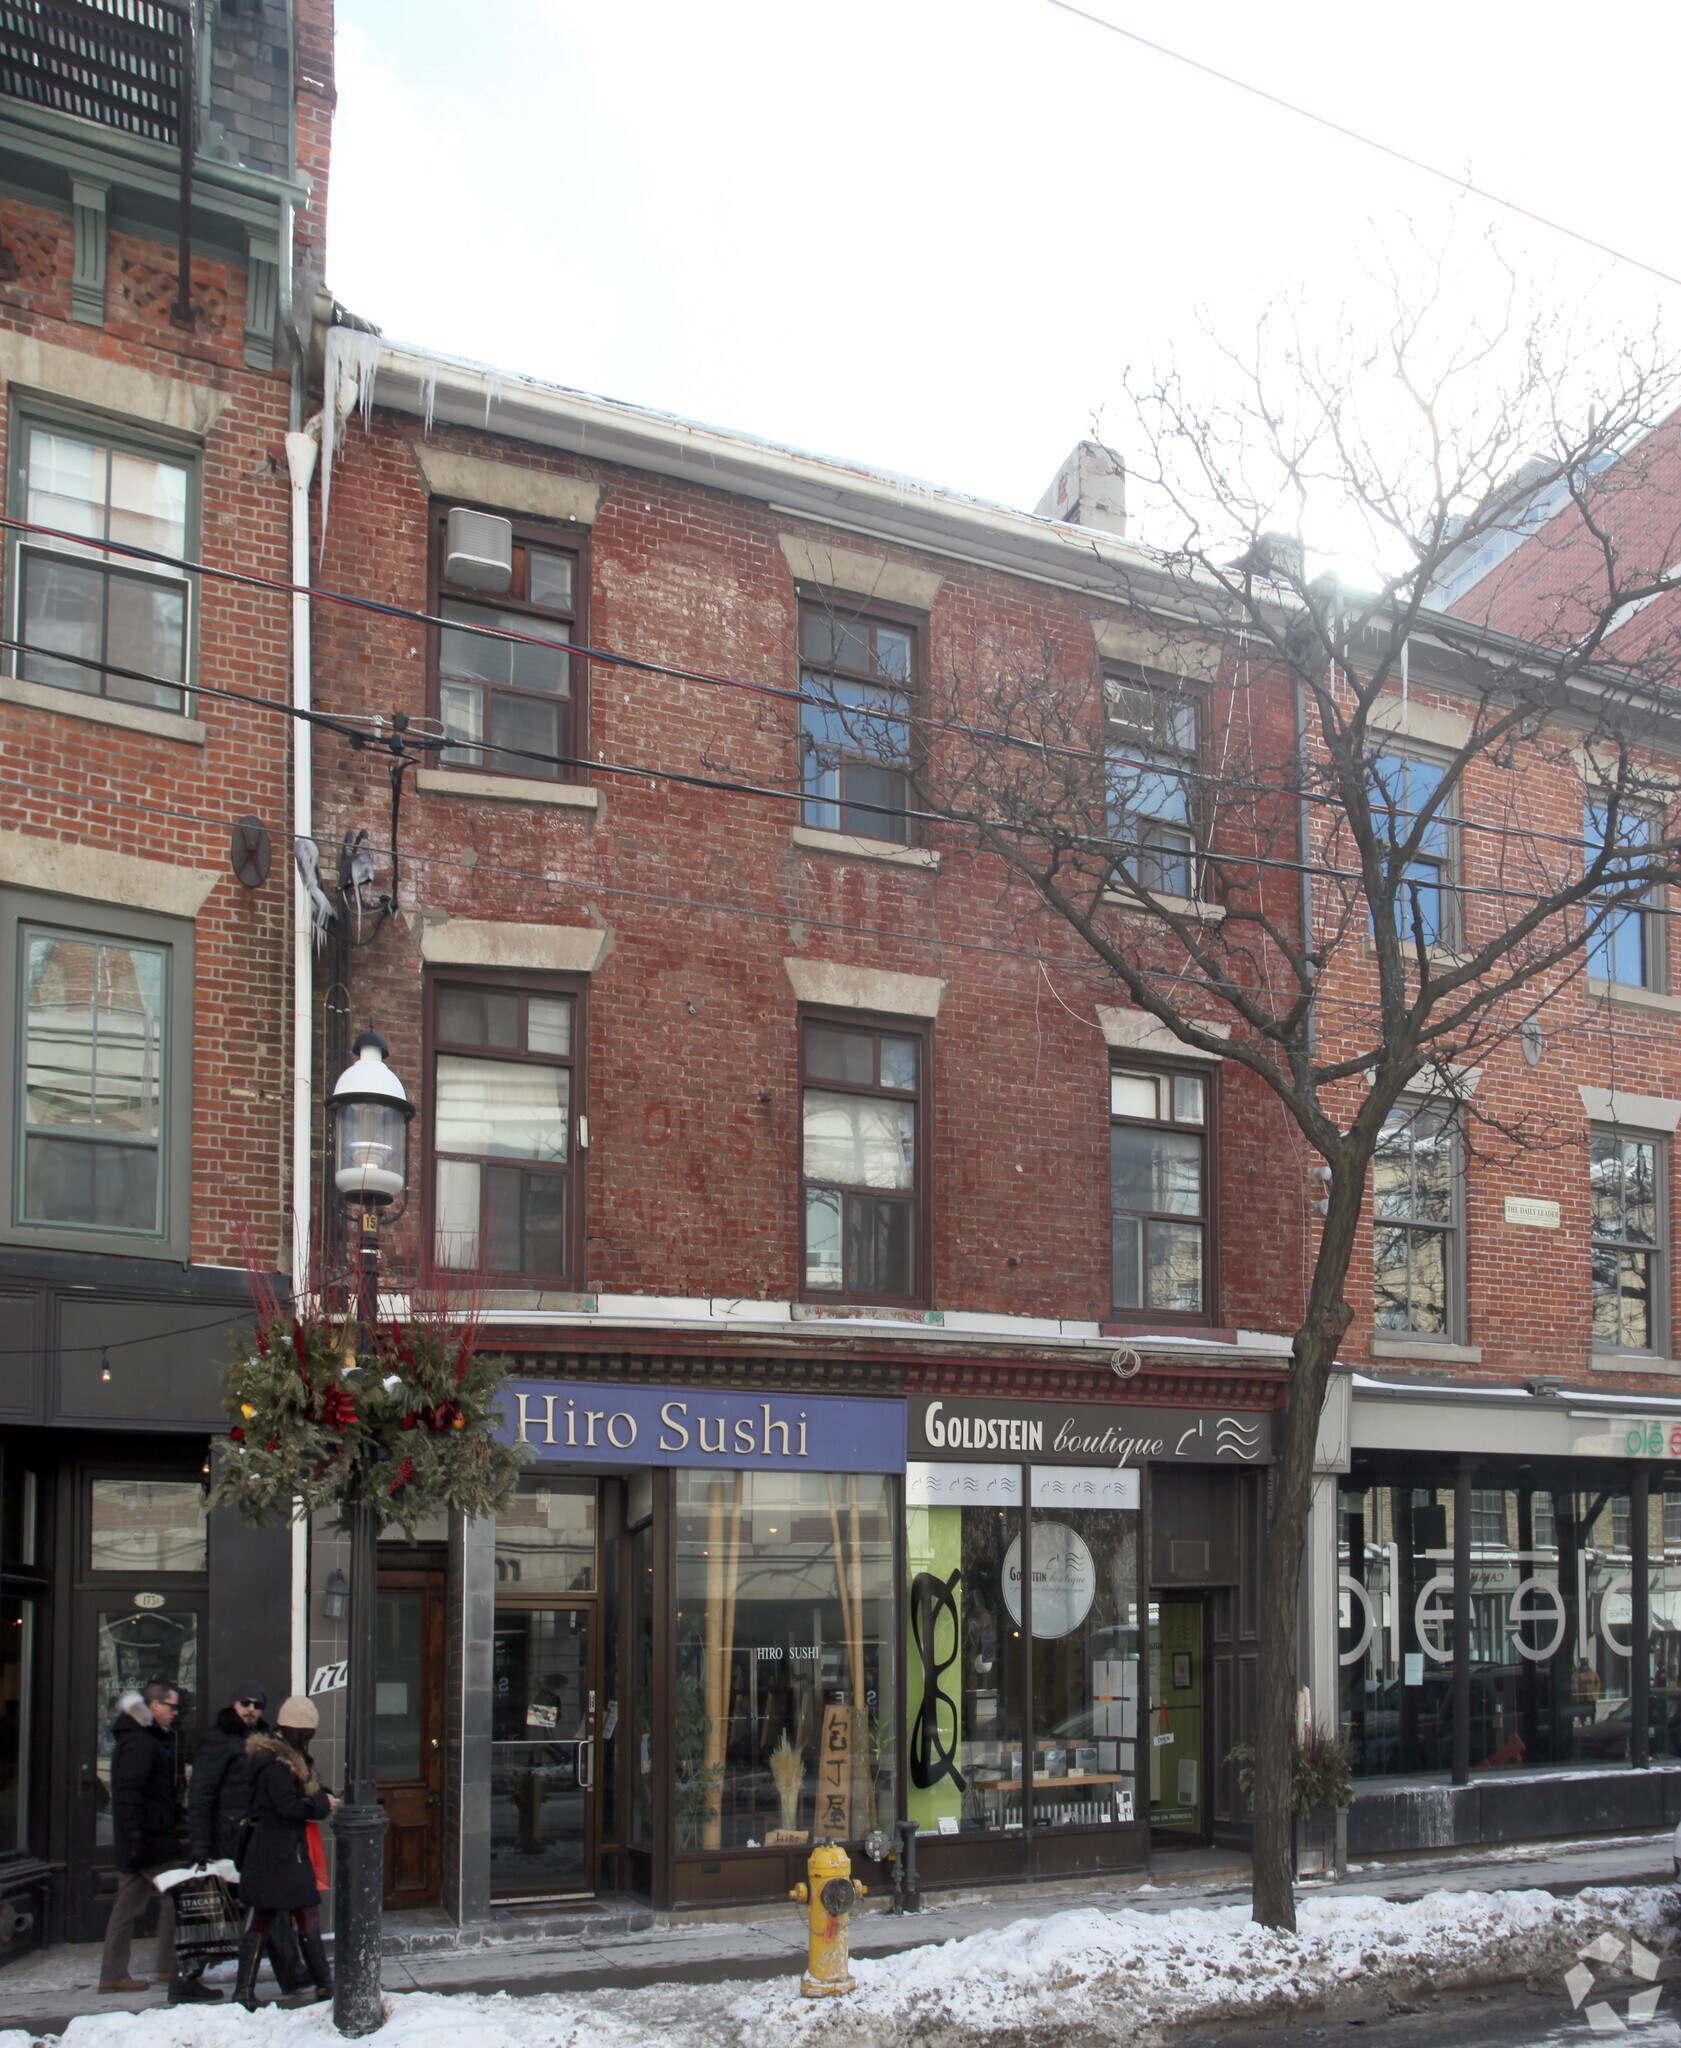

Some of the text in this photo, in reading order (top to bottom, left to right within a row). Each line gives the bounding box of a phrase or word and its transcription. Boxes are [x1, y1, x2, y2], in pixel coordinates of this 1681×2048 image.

[1507, 1205, 1559, 1218] THE DAILY LEADER
[365, 1216, 376, 1229] 15
[514, 1393, 809, 1456] Hiro Sushi
[925, 1401, 1164, 1468] GOLDSTEIN boutique
[757, 1646, 819, 1660] HIRO SUSHI
